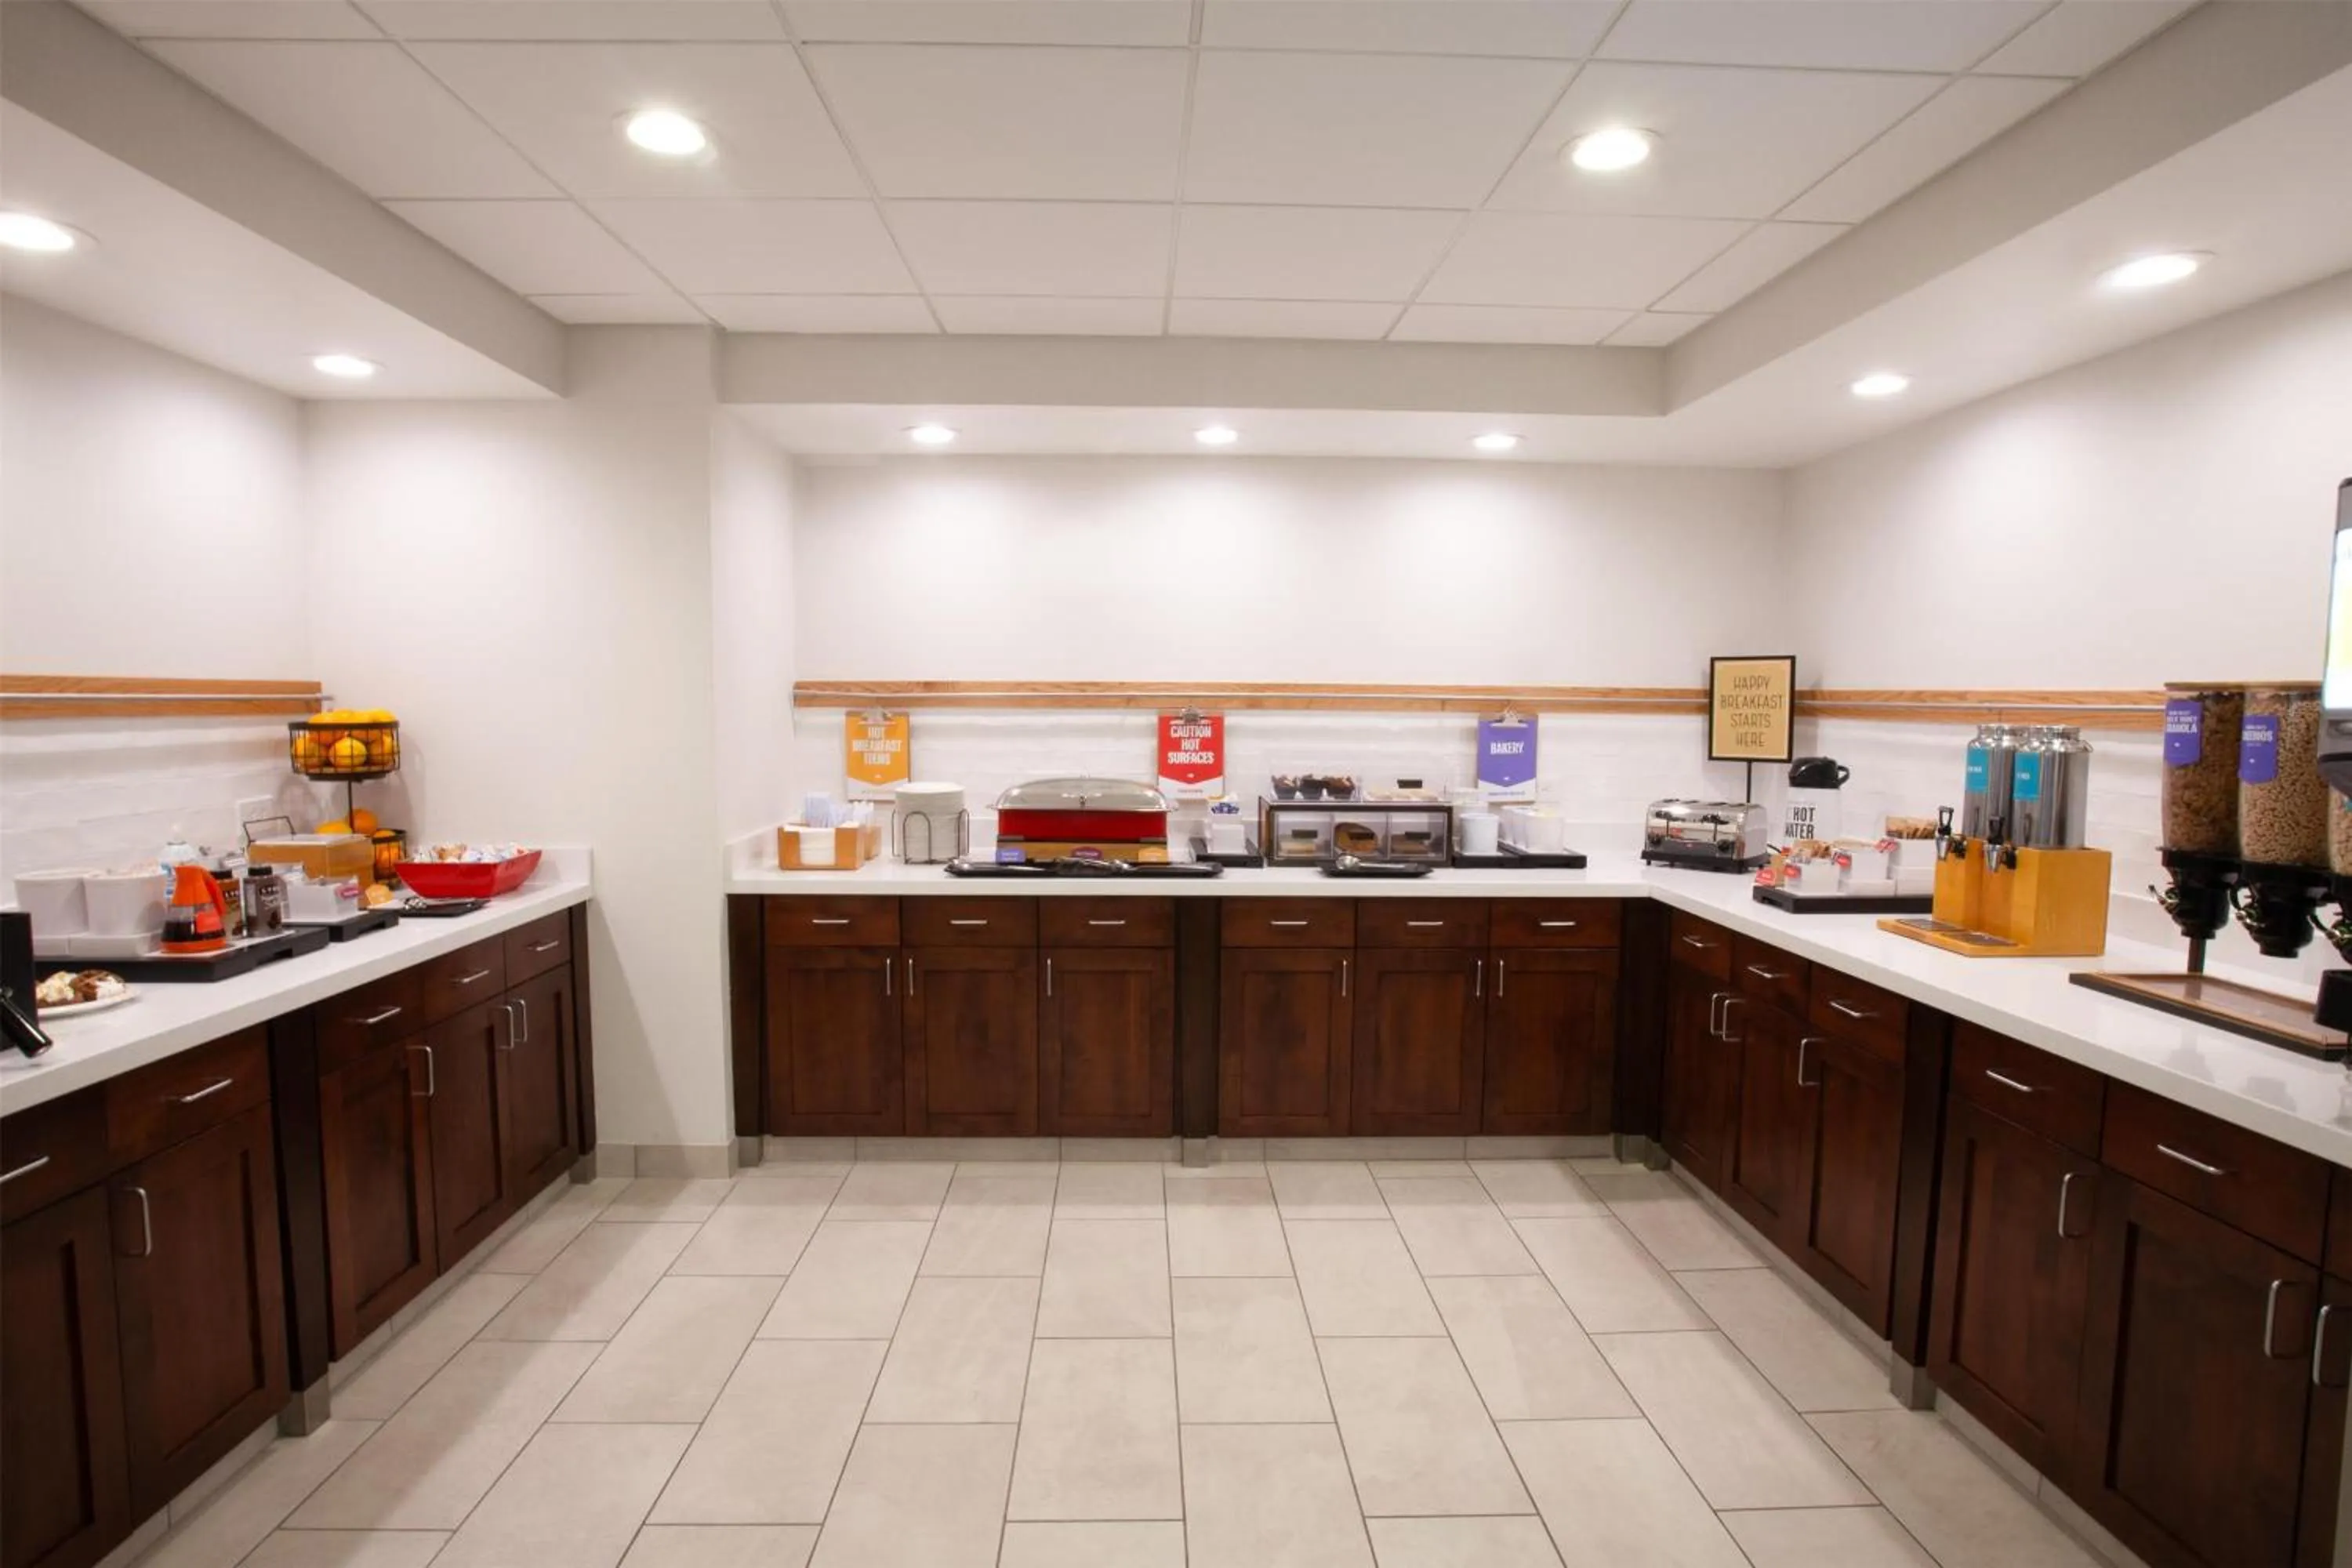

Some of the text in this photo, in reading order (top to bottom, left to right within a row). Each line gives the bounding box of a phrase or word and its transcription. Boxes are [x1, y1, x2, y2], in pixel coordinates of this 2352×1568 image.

[1733, 675, 1770, 690] HAPPY
[1720, 693, 1784, 710] BREAKFAST
[1730, 713, 1771, 728] STARTS
[1171, 725, 1211, 738] CAUTION
[1737, 731, 1767, 747] HERE
[1181, 739, 1200, 750] HOT
[1490, 741, 1525, 754] BAKERY
[1167, 752, 1215, 764] SURFACES
[1793, 806, 1816, 822] HOT
